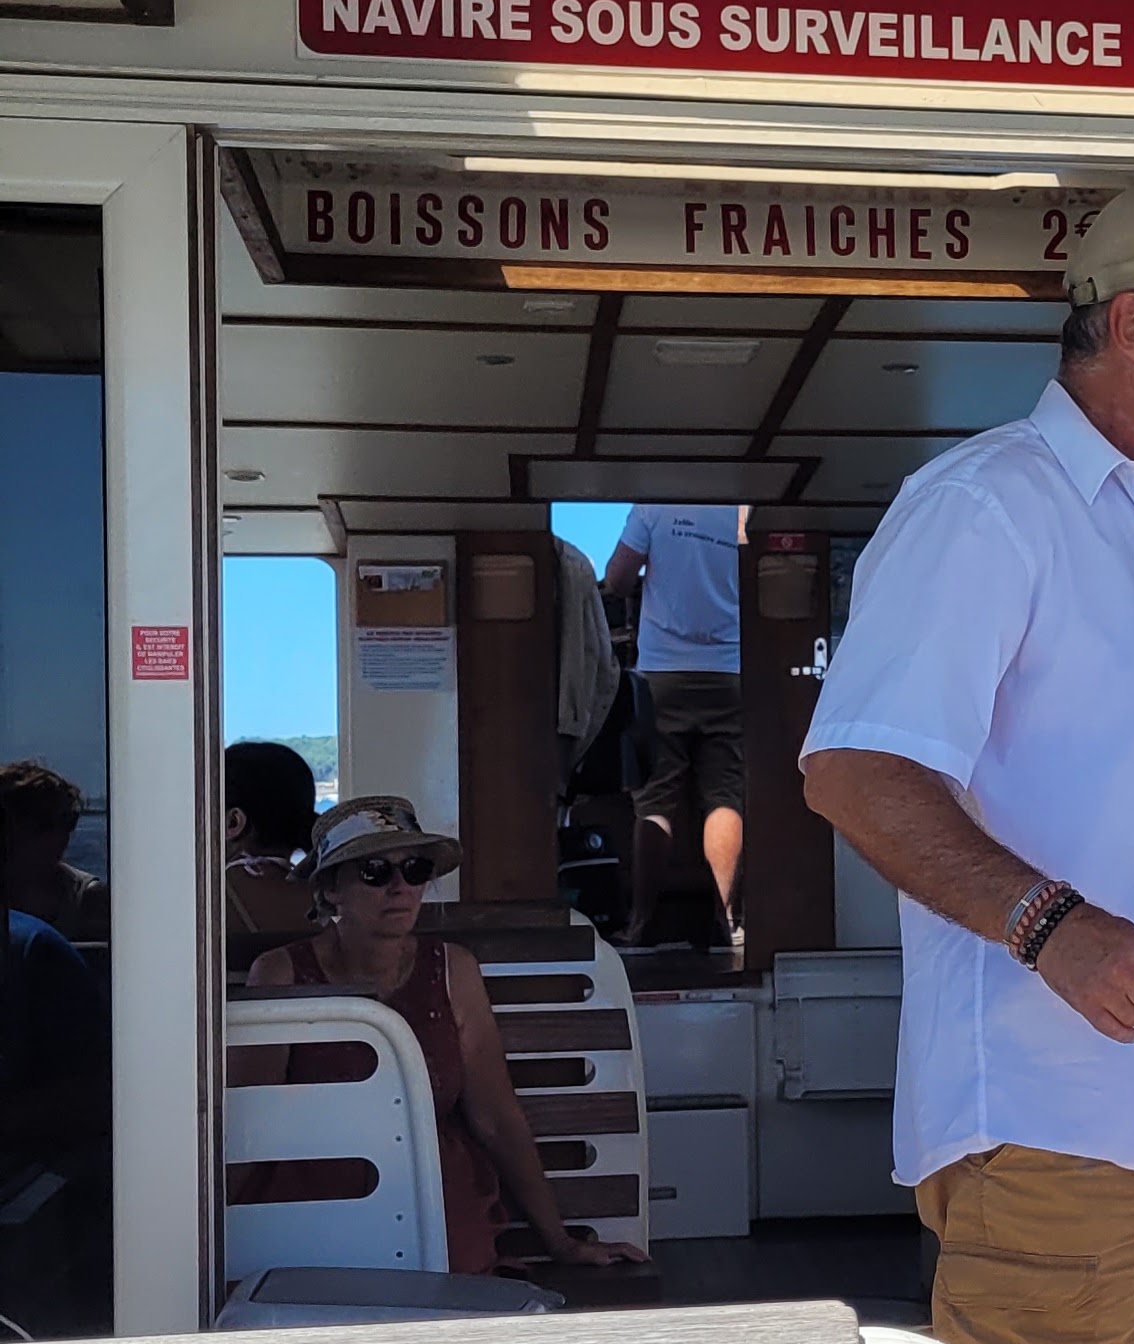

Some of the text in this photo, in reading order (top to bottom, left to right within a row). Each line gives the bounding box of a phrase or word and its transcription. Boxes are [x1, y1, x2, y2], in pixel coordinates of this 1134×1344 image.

[719, 4, 1122, 67] SURVEILLANCE
[306, 189, 610, 252] BOISSONS
[684, 202, 970, 260] FRAICHES
